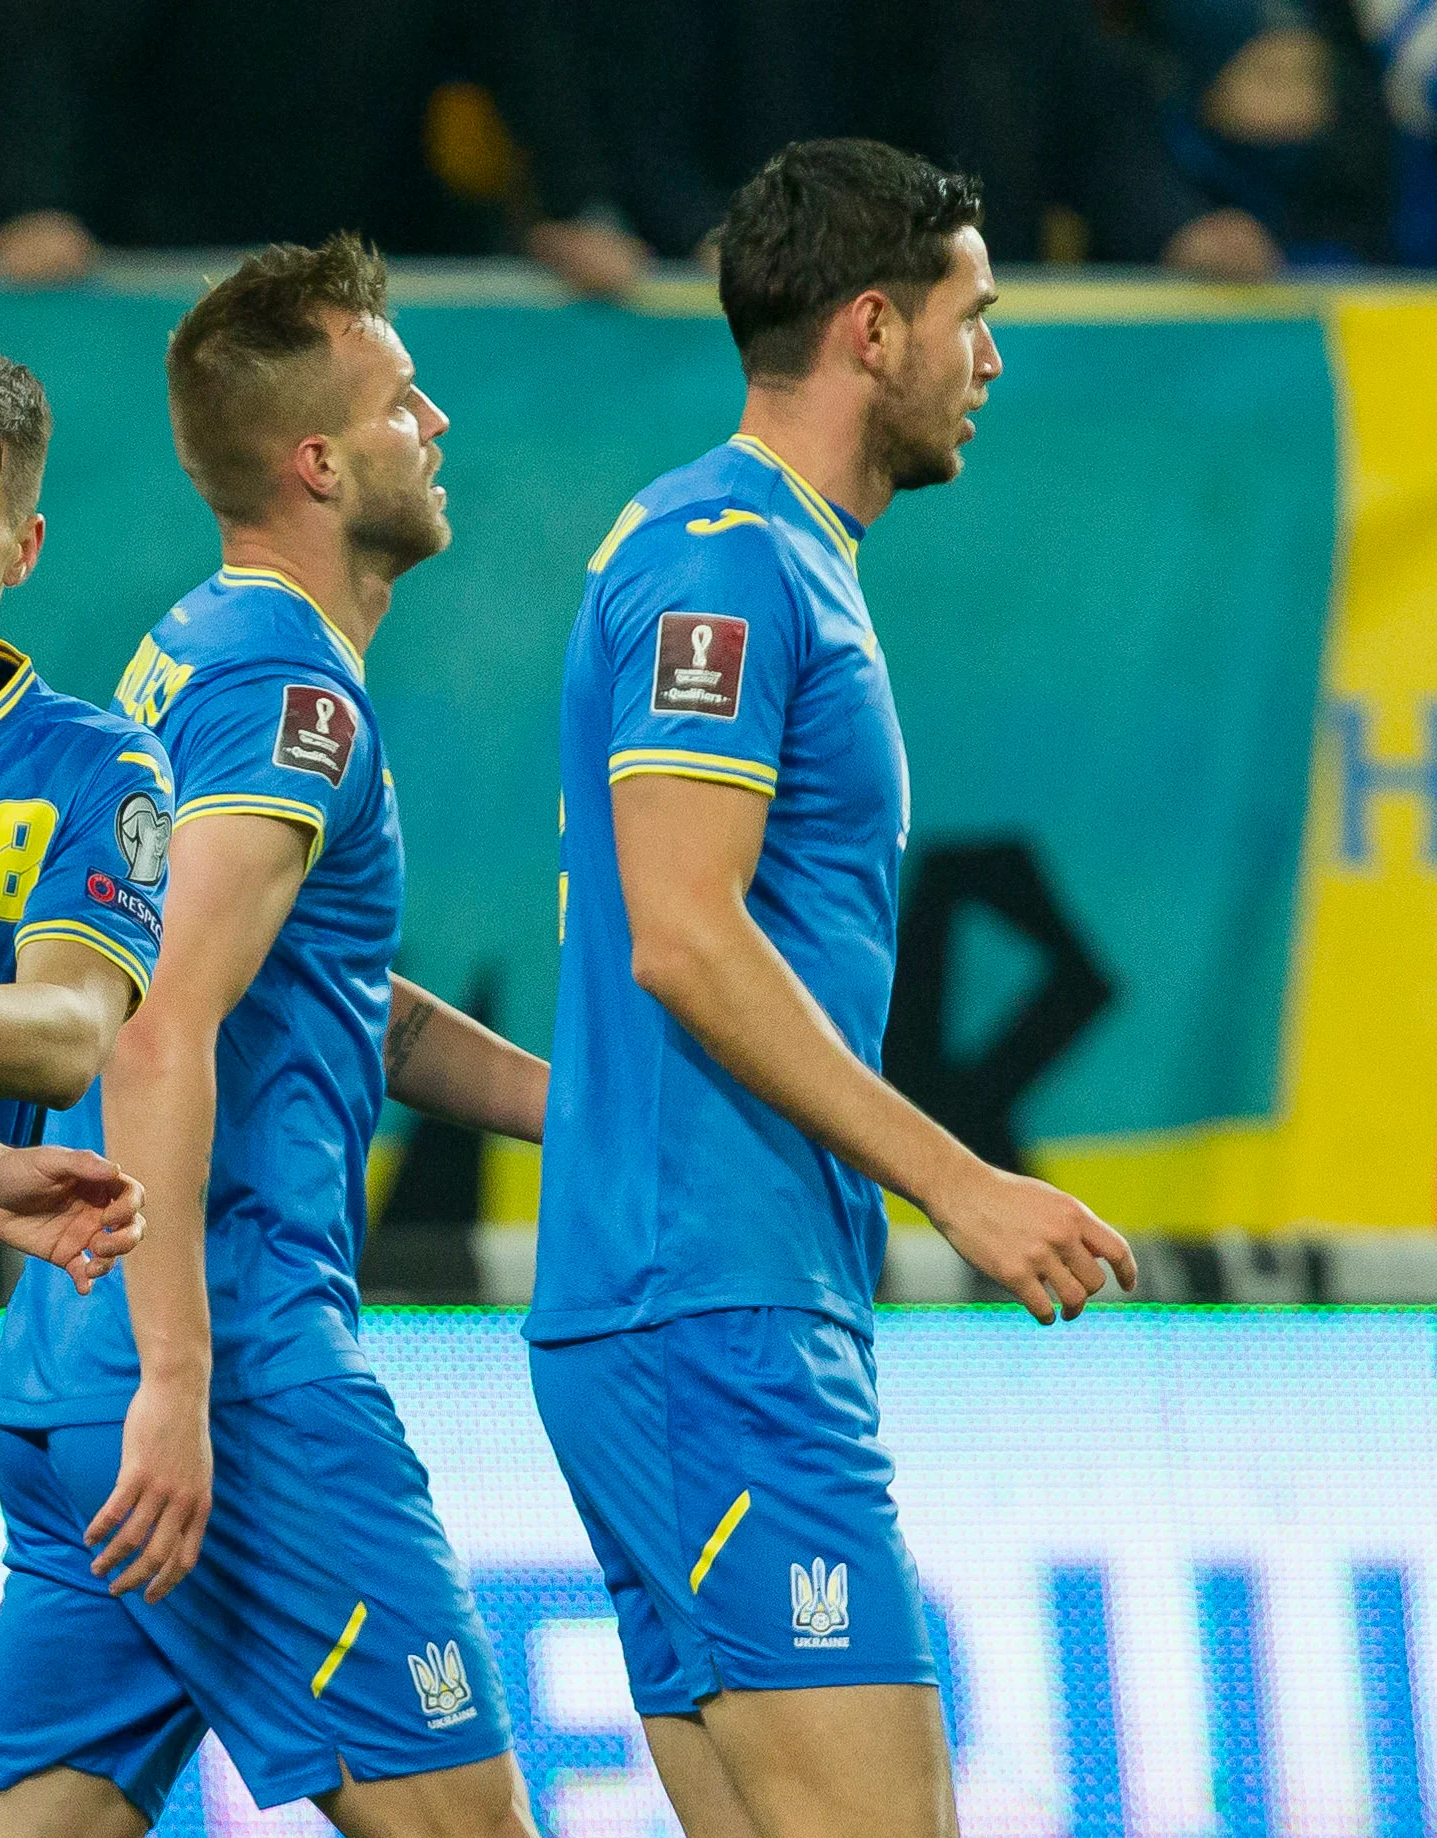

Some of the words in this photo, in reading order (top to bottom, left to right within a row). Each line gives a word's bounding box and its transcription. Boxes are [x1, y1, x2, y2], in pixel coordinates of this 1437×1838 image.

[116, 889, 163, 942] RESPEC
[793, 1636, 850, 1648] UKRAINE
[426, 1706, 478, 1730] UKRAINE
